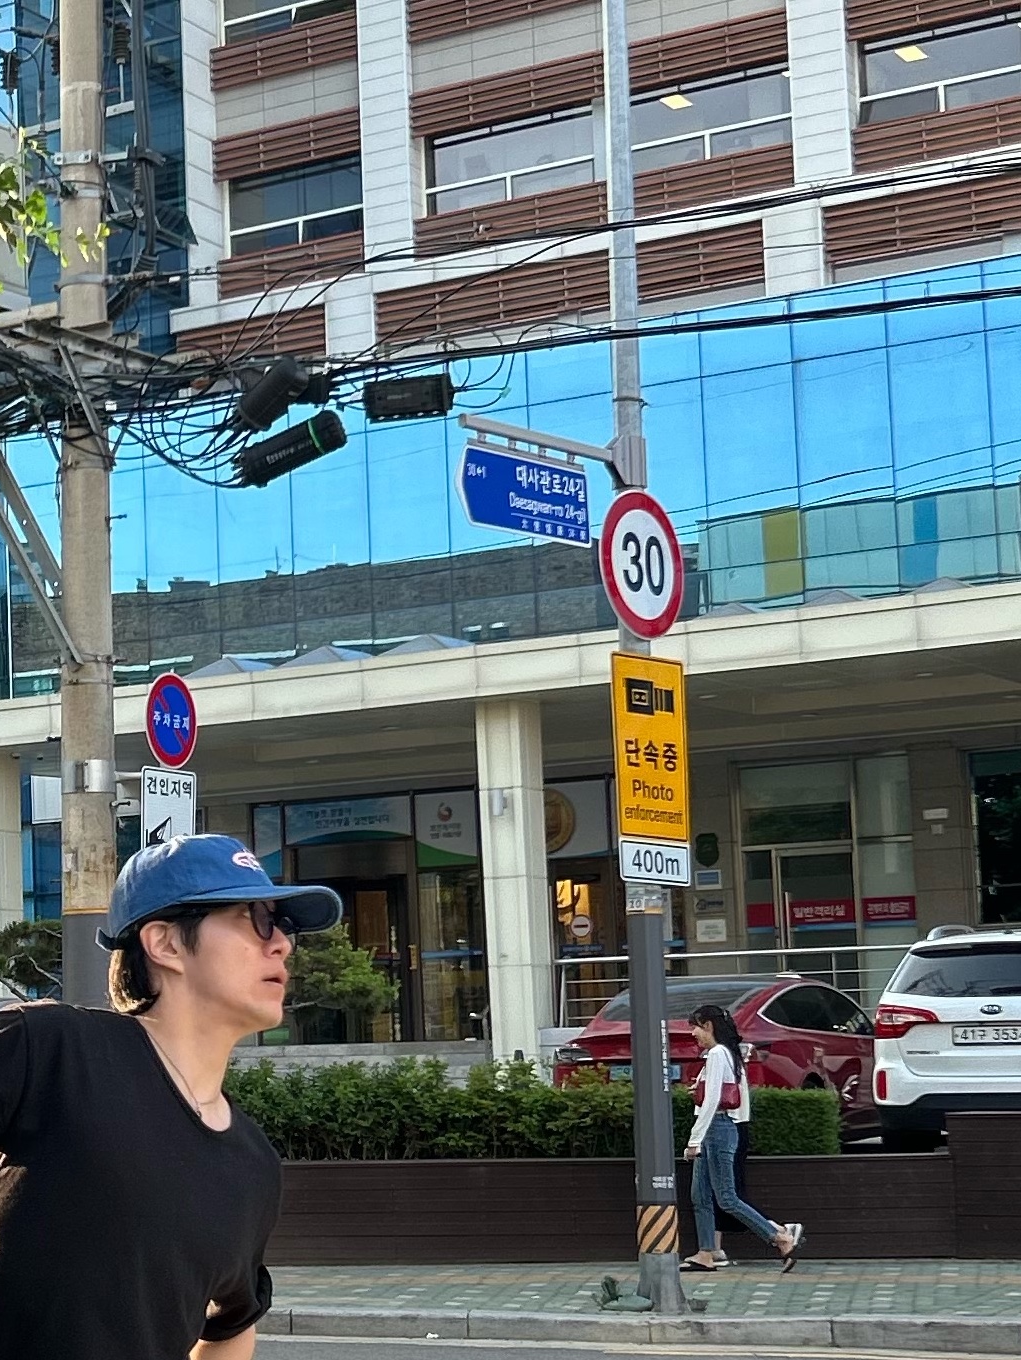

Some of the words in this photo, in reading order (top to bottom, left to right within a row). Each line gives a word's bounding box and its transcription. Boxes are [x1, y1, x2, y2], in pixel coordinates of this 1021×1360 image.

[516, 464, 586, 503] 대사관로24길
[622, 531, 665, 597] 30
[153, 710, 190, 731] 주차금지
[624, 738, 679, 772] 단속중
[147, 776, 192, 800] 견인지역
[632, 779, 674, 801] Photo
[624, 804, 683, 826] enforcement
[632, 849, 680, 876] 400m
[793, 904, 845, 918] 일반격리실
